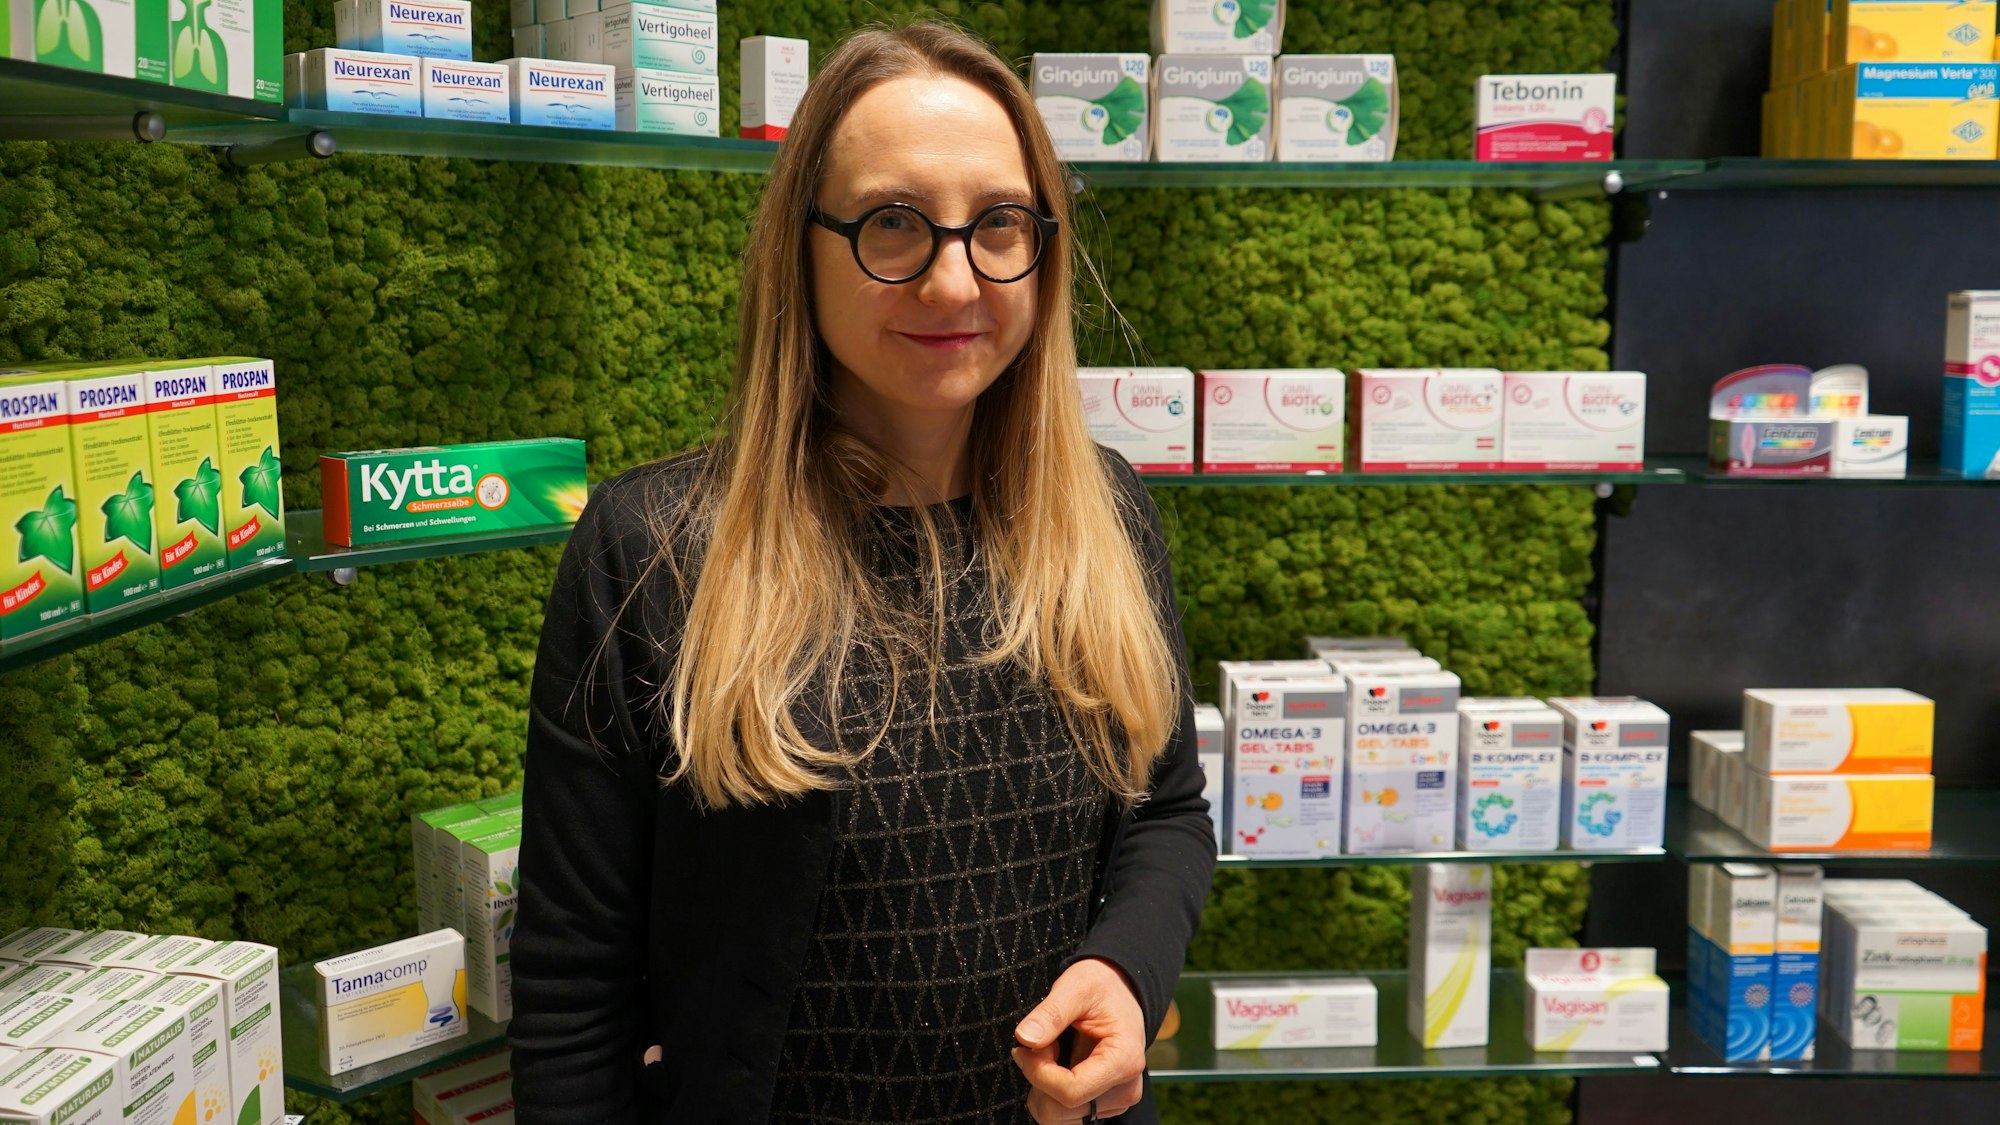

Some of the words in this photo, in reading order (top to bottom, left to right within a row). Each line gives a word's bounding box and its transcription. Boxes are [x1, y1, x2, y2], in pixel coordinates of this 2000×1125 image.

[390, 4, 462, 24] Neurexan
[638, 18, 711, 40] Vertigoheel
[138, 57, 148, 68] 20
[334, 60, 410, 80] Neurexan
[1125, 60, 1145, 72] 120
[1250, 61, 1268, 72] 120
[1370, 62, 1389, 72] 120
[256, 79, 264, 90] 20
[432, 69, 500, 88] Neurexan
[529, 71, 603, 91] Neurexan
[1038, 66, 1118, 88] Gingium
[1163, 66, 1242, 89] Gingium
[1284, 67, 1363, 88] Gingium
[1863, 67, 1938, 82] Magnesium
[1941, 67, 1973, 80] Verla
[1979, 68, 1997, 80] 300
[615, 80, 632, 91] goheel
[641, 82, 712, 102] Vertigoheel
[1490, 81, 1583, 100] Tebonin
[155, 376, 206, 398] PROSPAN
[222, 369, 268, 390] PROSPAN
[0, 392, 58, 418] ROSPAN
[80, 384, 136, 408] PROSPAN
[1763, 426, 1817, 439] Centrum
[1854, 427, 1893, 438] Centrum
[361, 459, 473, 511] Kytta
[412, 499, 470, 511] Schmerzsalbe
[231, 532, 240, 545] für
[239, 520, 257, 540] Kinder
[364, 525, 374, 533] Bei
[376, 521, 414, 532] Schmerzen
[416, 519, 428, 527] und
[429, 515, 476, 526] Schwellungen
[165, 550, 175, 563] für
[175, 537, 194, 558] Kinder
[256, 548, 265, 556] 100
[92, 573, 102, 585] für
[101, 557, 123, 579] Kinder
[193, 566, 204, 575] 100
[4, 596, 16, 608] für
[16, 579, 40, 601] Kinder
[123, 588, 134, 597] 100
[1241, 728, 1321, 739] OMEGA-3
[1358, 723, 1436, 734] OMEGA-3
[1240, 743, 1314, 753] GEL-TABS
[1434, 888, 1488, 906] Vagisan
[240, 963, 272, 987] NATURALIS
[332, 959, 427, 995] Tannacomp
[1227, 999, 1298, 1022] Vagisan
[1543, 998, 1608, 1018] Vagisan
[138, 1020, 182, 1059] NATURALIS
[130, 1064, 150, 1082] HUSTEN
[131, 1074, 148, 1090] OBERE
[149, 1053, 175, 1076] ATEMWEGE
[24, 1060, 81, 1104] NATURALIS
[60, 1075, 110, 1120] NATURALIS
